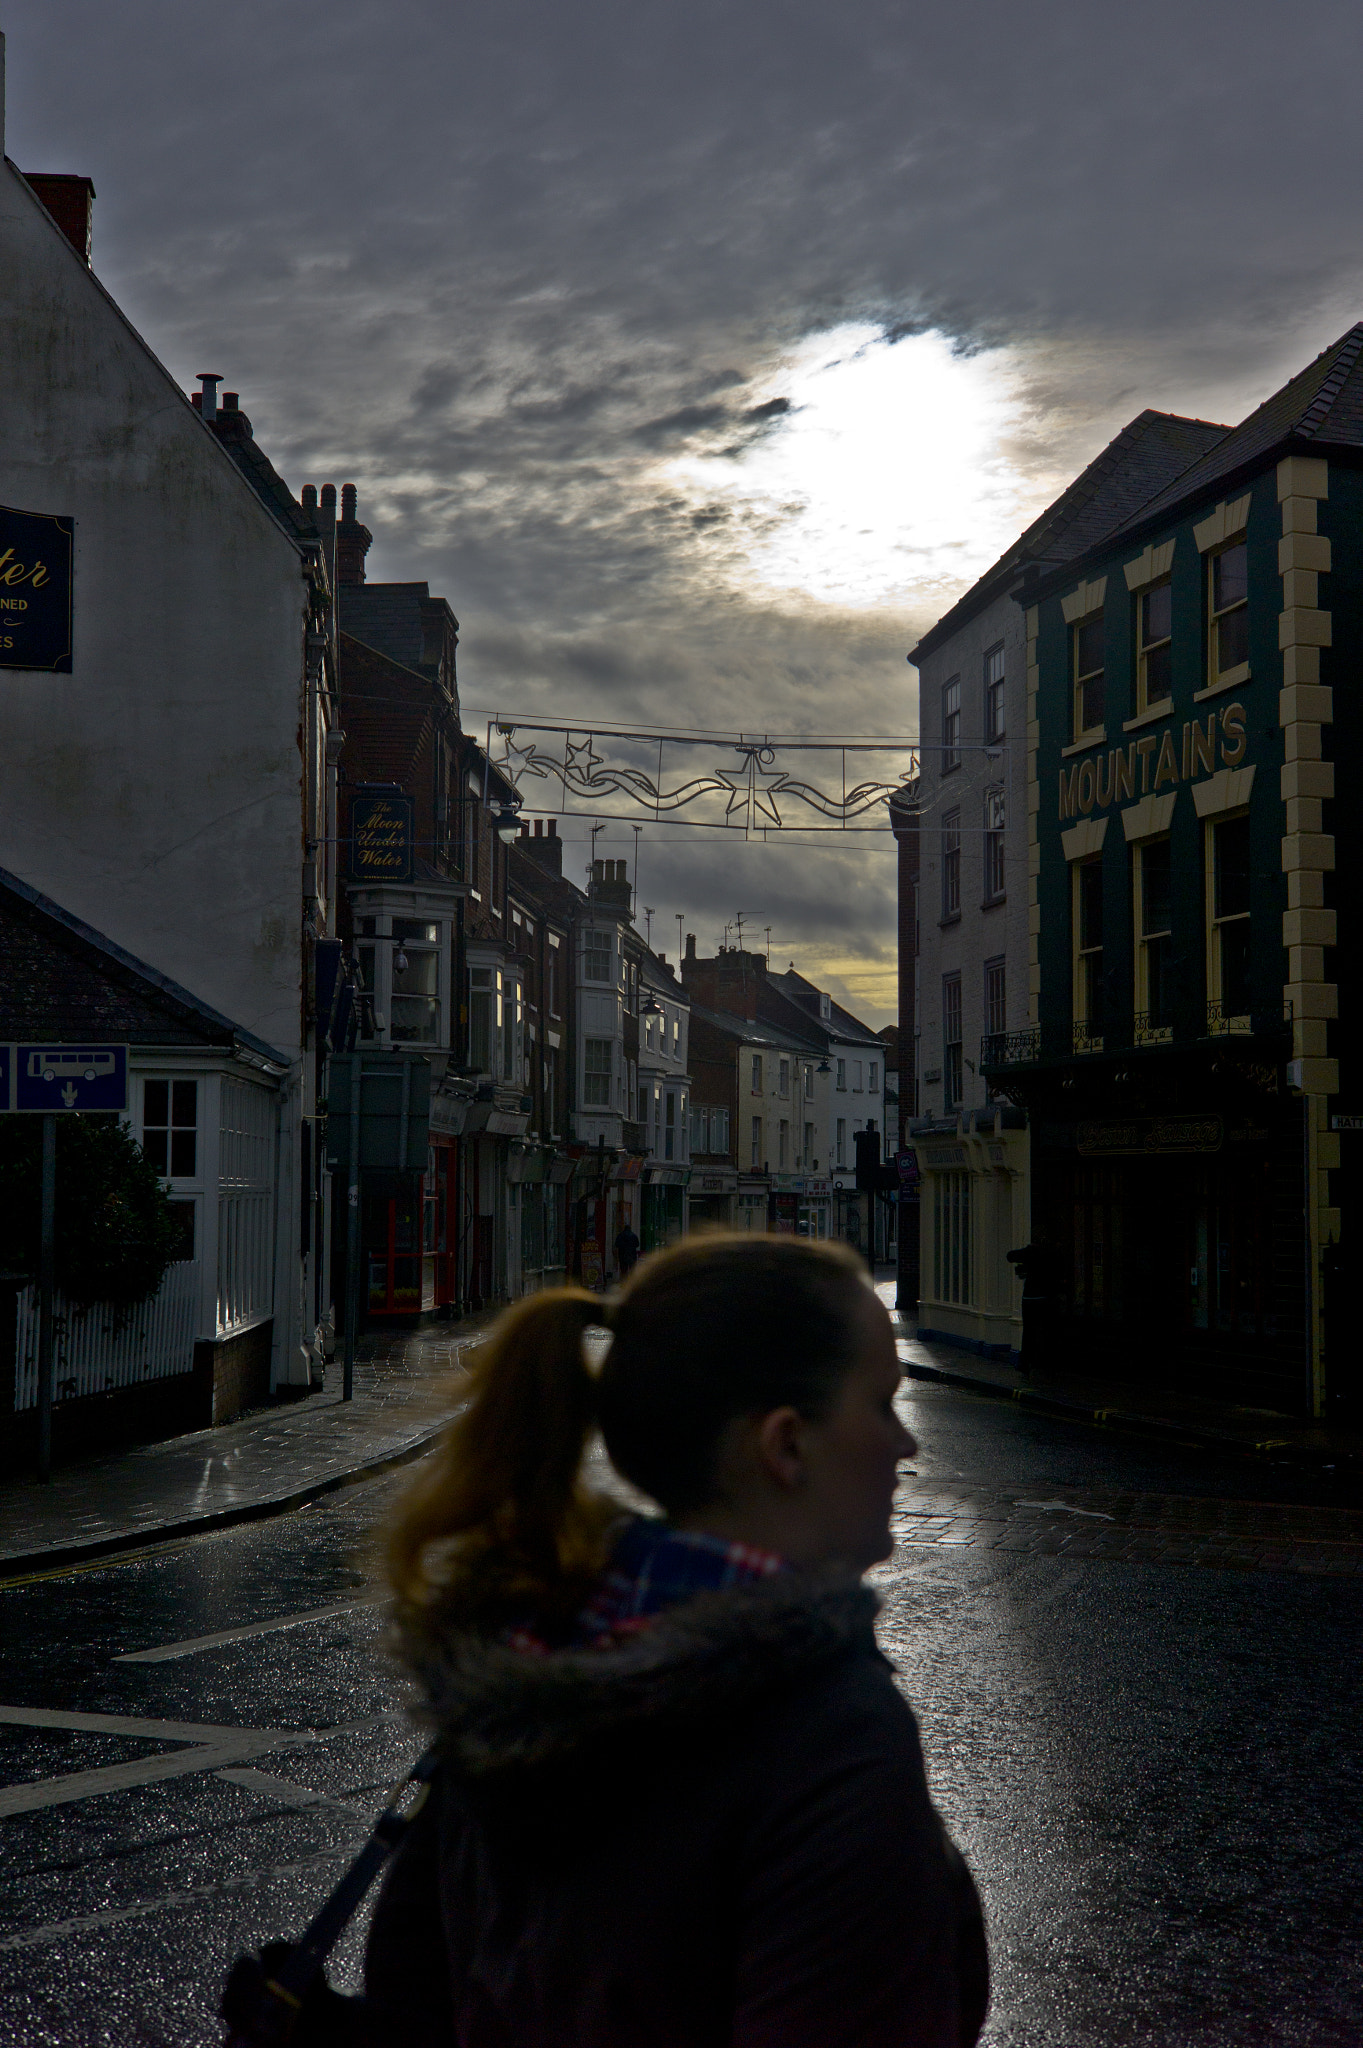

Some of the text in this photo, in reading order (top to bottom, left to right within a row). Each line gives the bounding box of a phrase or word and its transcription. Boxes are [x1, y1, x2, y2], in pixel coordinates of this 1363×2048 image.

[1058, 702, 1248, 821] MOUNTAIN'S
[371, 802, 392, 813] The
[357, 814, 405, 829] Moon
[356, 830, 405, 847] Under
[358, 850, 402, 866] Water
[1144, 1114, 1220, 1152] Sausage
